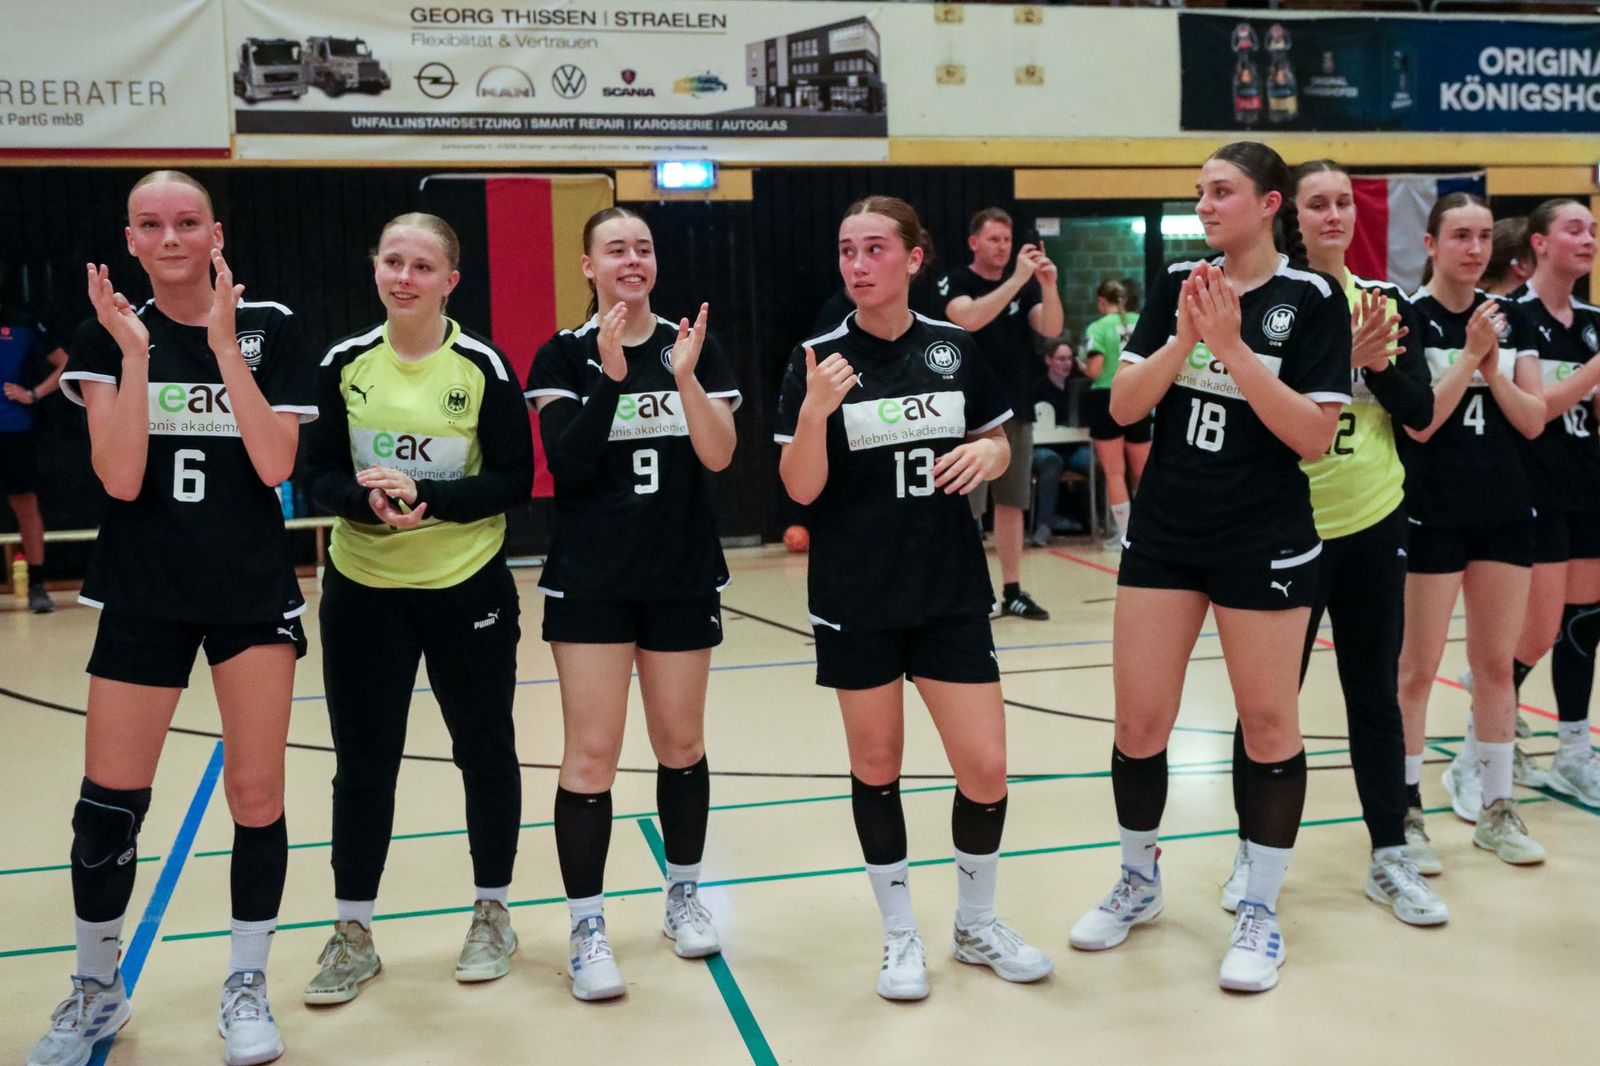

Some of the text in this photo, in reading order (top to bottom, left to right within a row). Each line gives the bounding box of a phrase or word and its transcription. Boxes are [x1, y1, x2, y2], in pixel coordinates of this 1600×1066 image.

[410, 7, 727, 28] GEORG THISSEN STRAELEN
[411, 32, 599, 49] Flexibilität & Vertrauen
[0, 80, 167, 106] RBERATER
[602, 87, 656, 97] SCANIA
[8, 113, 48, 126] PartG
[52, 113, 84, 126] mbB
[351, 116, 788, 131] UNFALLINSTANDSETZUNG SMART REPAIR KAROSSERIE AUTOGLAS
[1188, 343, 1228, 375] ea
[158, 384, 231, 413] eak
[615, 392, 674, 420] eak
[877, 395, 942, 424] eak
[1186, 398, 1226, 452] 18
[1463, 394, 1485, 435] 4
[372, 431, 432, 462] eak
[850, 430, 898, 447] erlebnis
[1325, 412, 1356, 455] 2
[173, 449, 206, 502] 6
[632, 448, 660, 495] 9
[894, 448, 936, 498] 13
